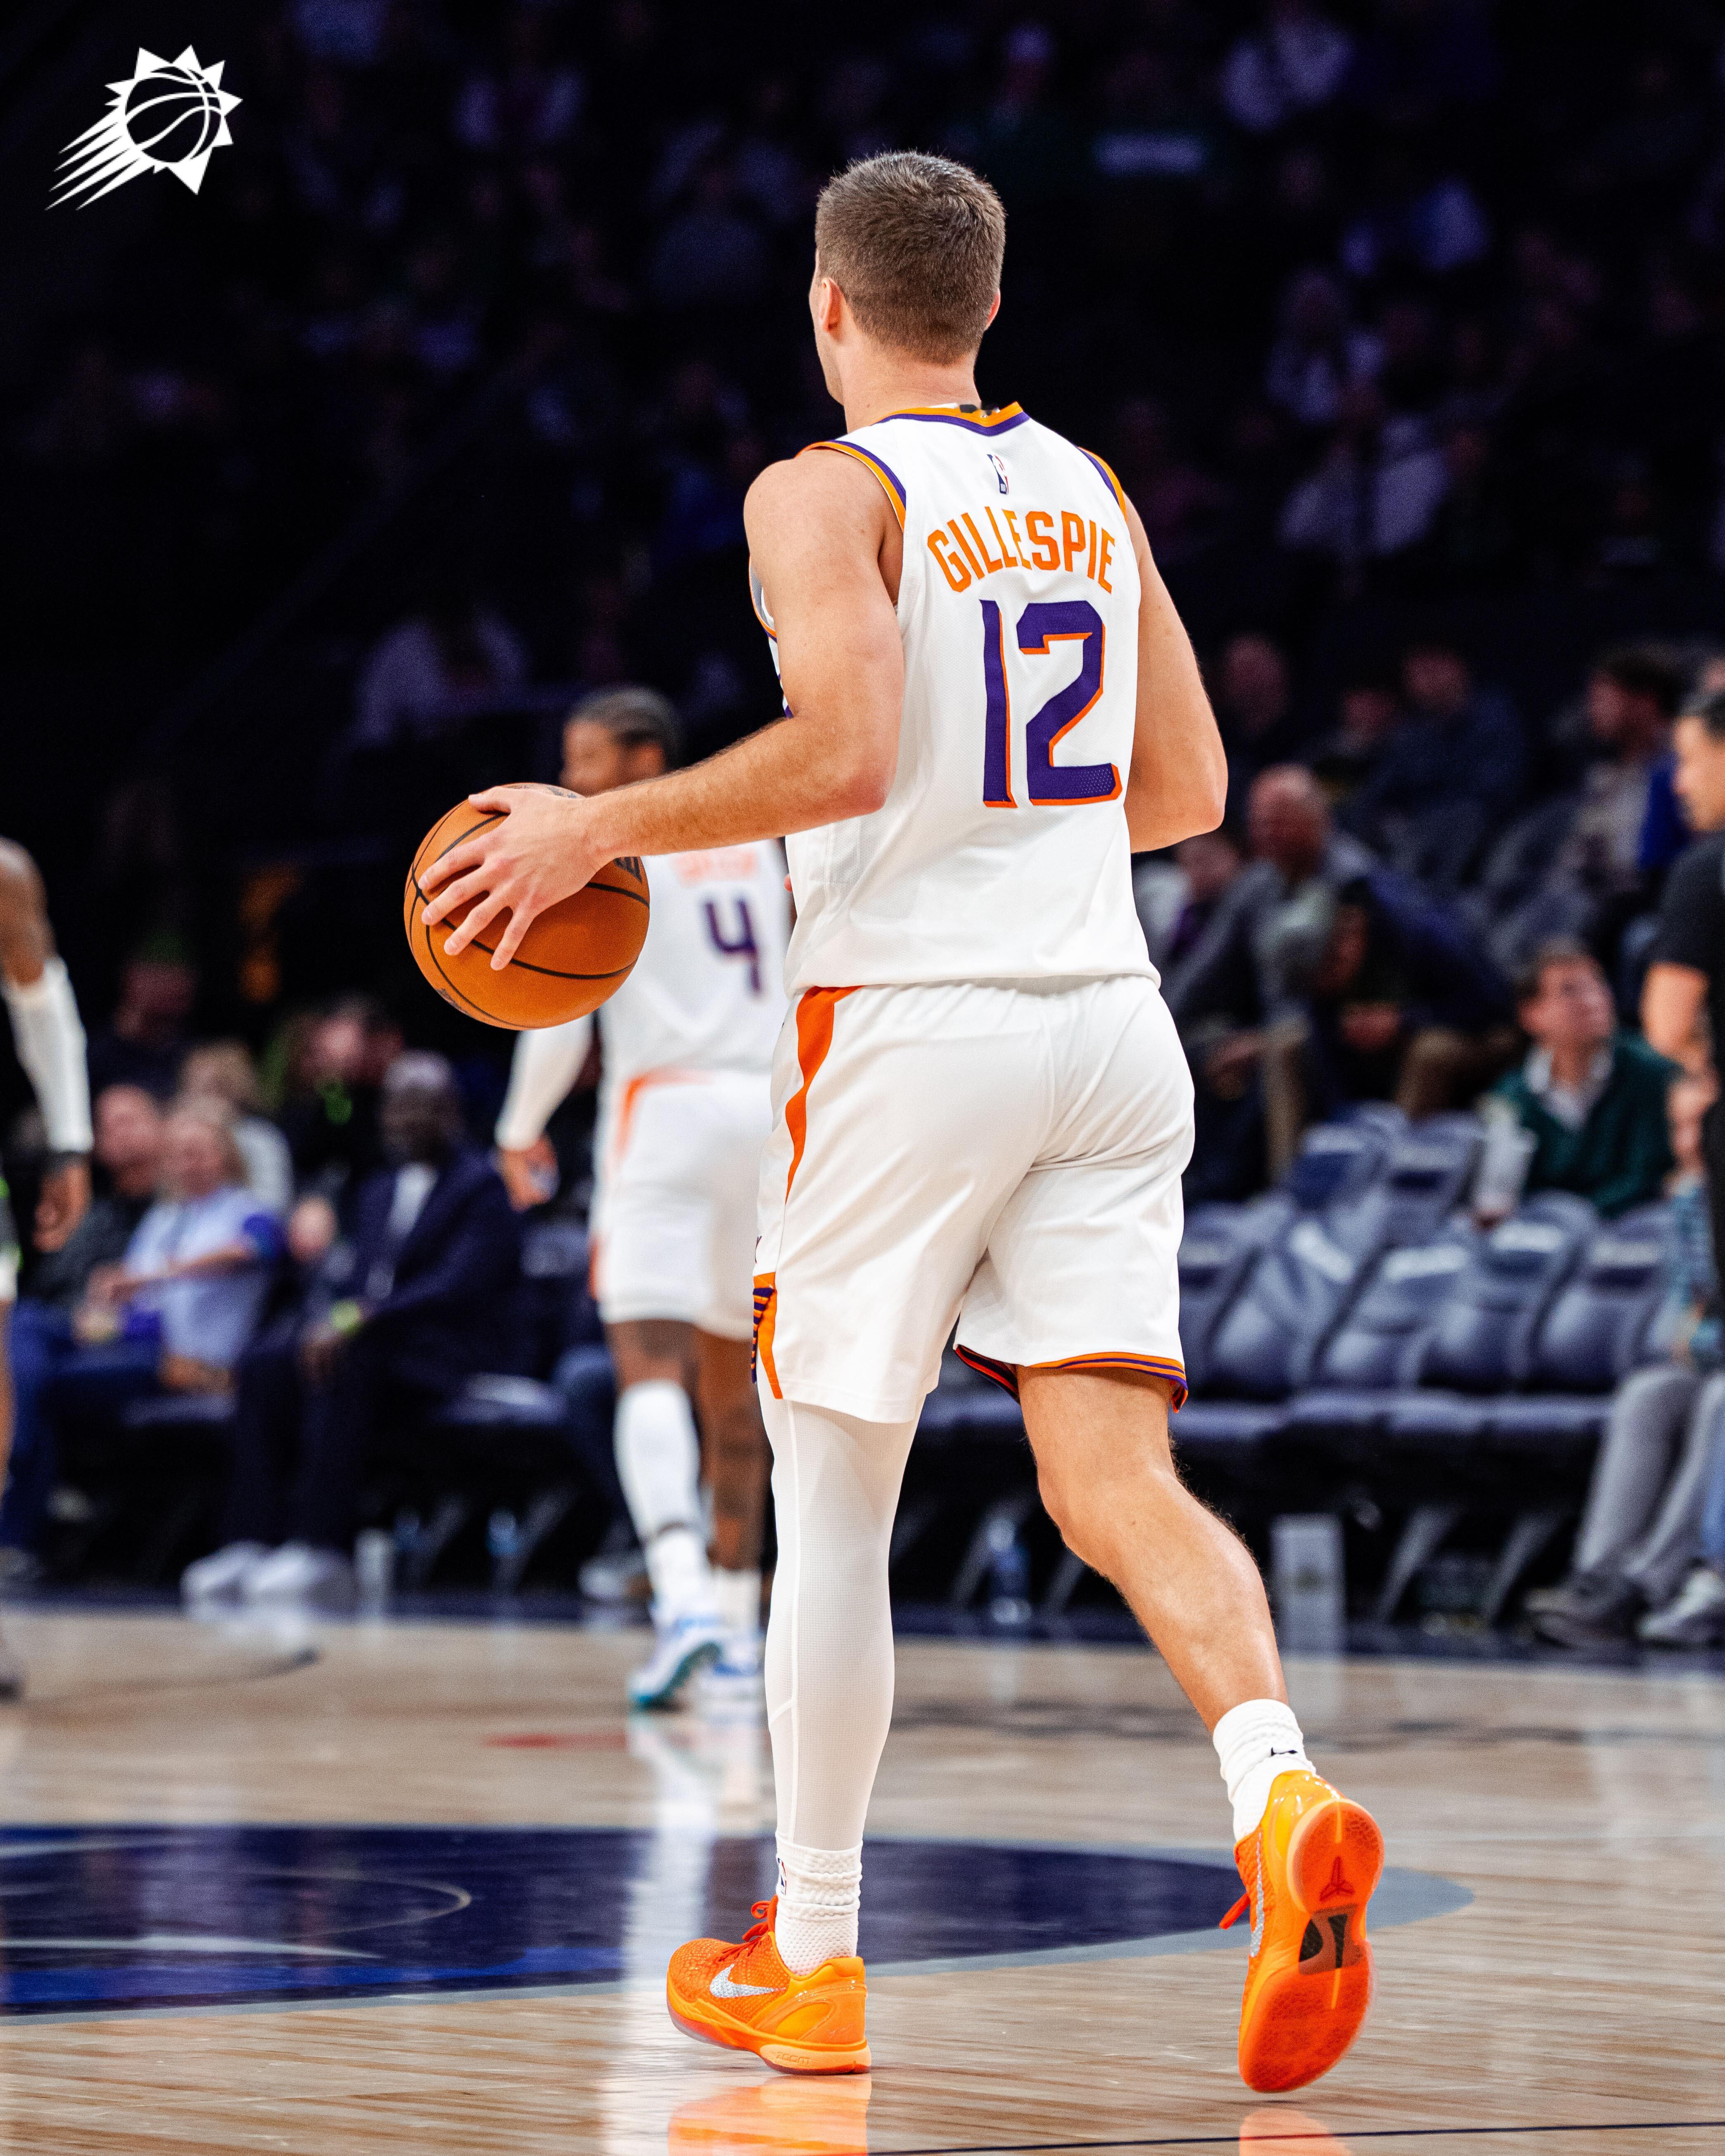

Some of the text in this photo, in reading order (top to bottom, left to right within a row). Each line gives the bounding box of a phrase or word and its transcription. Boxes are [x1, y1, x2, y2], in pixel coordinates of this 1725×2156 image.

[927, 506, 1115, 594] GILLESPIE
[980, 599, 1123, 808] 12
[704, 894, 763, 996] 4
